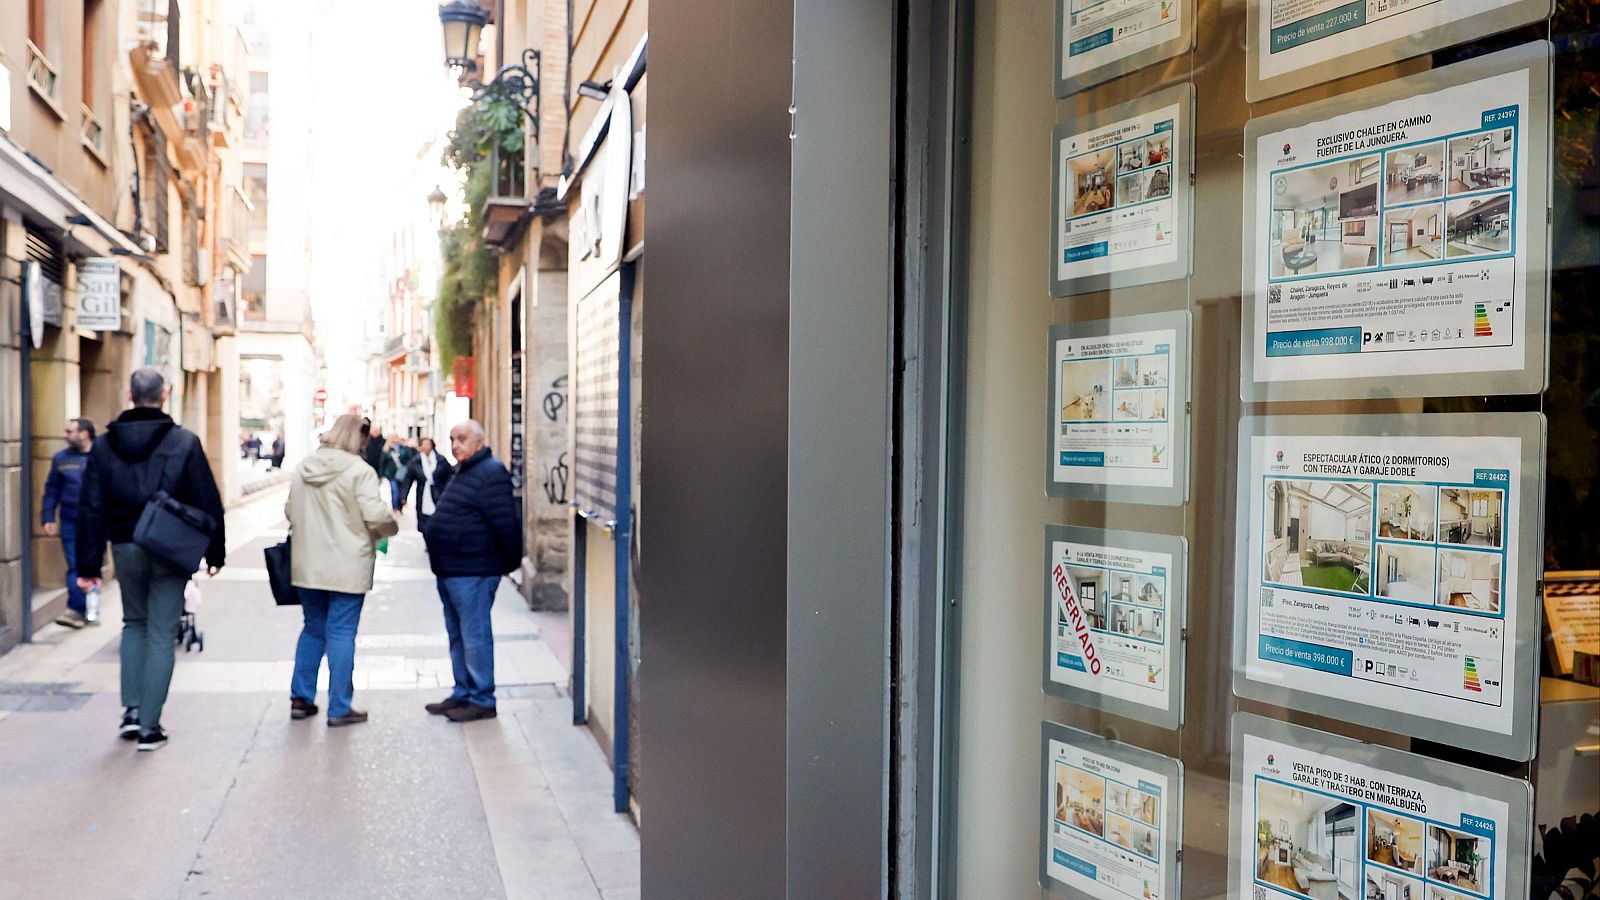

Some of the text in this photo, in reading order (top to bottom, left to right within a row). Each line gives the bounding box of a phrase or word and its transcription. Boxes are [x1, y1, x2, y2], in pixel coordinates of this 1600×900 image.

[1278, 32, 1296, 44] Precio
[1298, 28, 1305, 37] de
[1306, 23, 1324, 34] venta
[1326, 12, 1352, 28] 227.000
[1354, 10, 1358, 19] €
[1484, 110, 1516, 122] REF. 24397
[1318, 114, 1432, 147] EXCLUSIVO CHALET EN CAMINO
[1317, 131, 1408, 158] FUENTE DE LA JUNQUERA.
[81, 296, 115, 313] Gil
[1272, 336, 1354, 349] Precio de venta 998.000 €
[1304, 453, 1450, 468] ESPECTACULAR ÁTICO (2 DORMITORIOS)
[1304, 464, 1416, 476] CON TERRAZA Y GARAJE DOBLE
[1294, 600, 1314, 610] Zaragoza,
[1053, 564, 1101, 675] RESERVADO
[1265, 643, 1345, 667] Precio de venta 398.000 €
[1292, 762, 1314, 774] VENTA
[1316, 768, 1331, 778] PISO
[1334, 772, 1342, 782] DE
[1344, 774, 1348, 783] 3
[1350, 776, 1367, 788] HAB.
[1370, 780, 1384, 792] CON
[1386, 785, 1424, 803] TERRAZA,
[1292, 773, 1426, 814] GARAJE Y TRASTERO EN MIRALBUENO
[1463, 817, 1493, 831] REF. 24426
